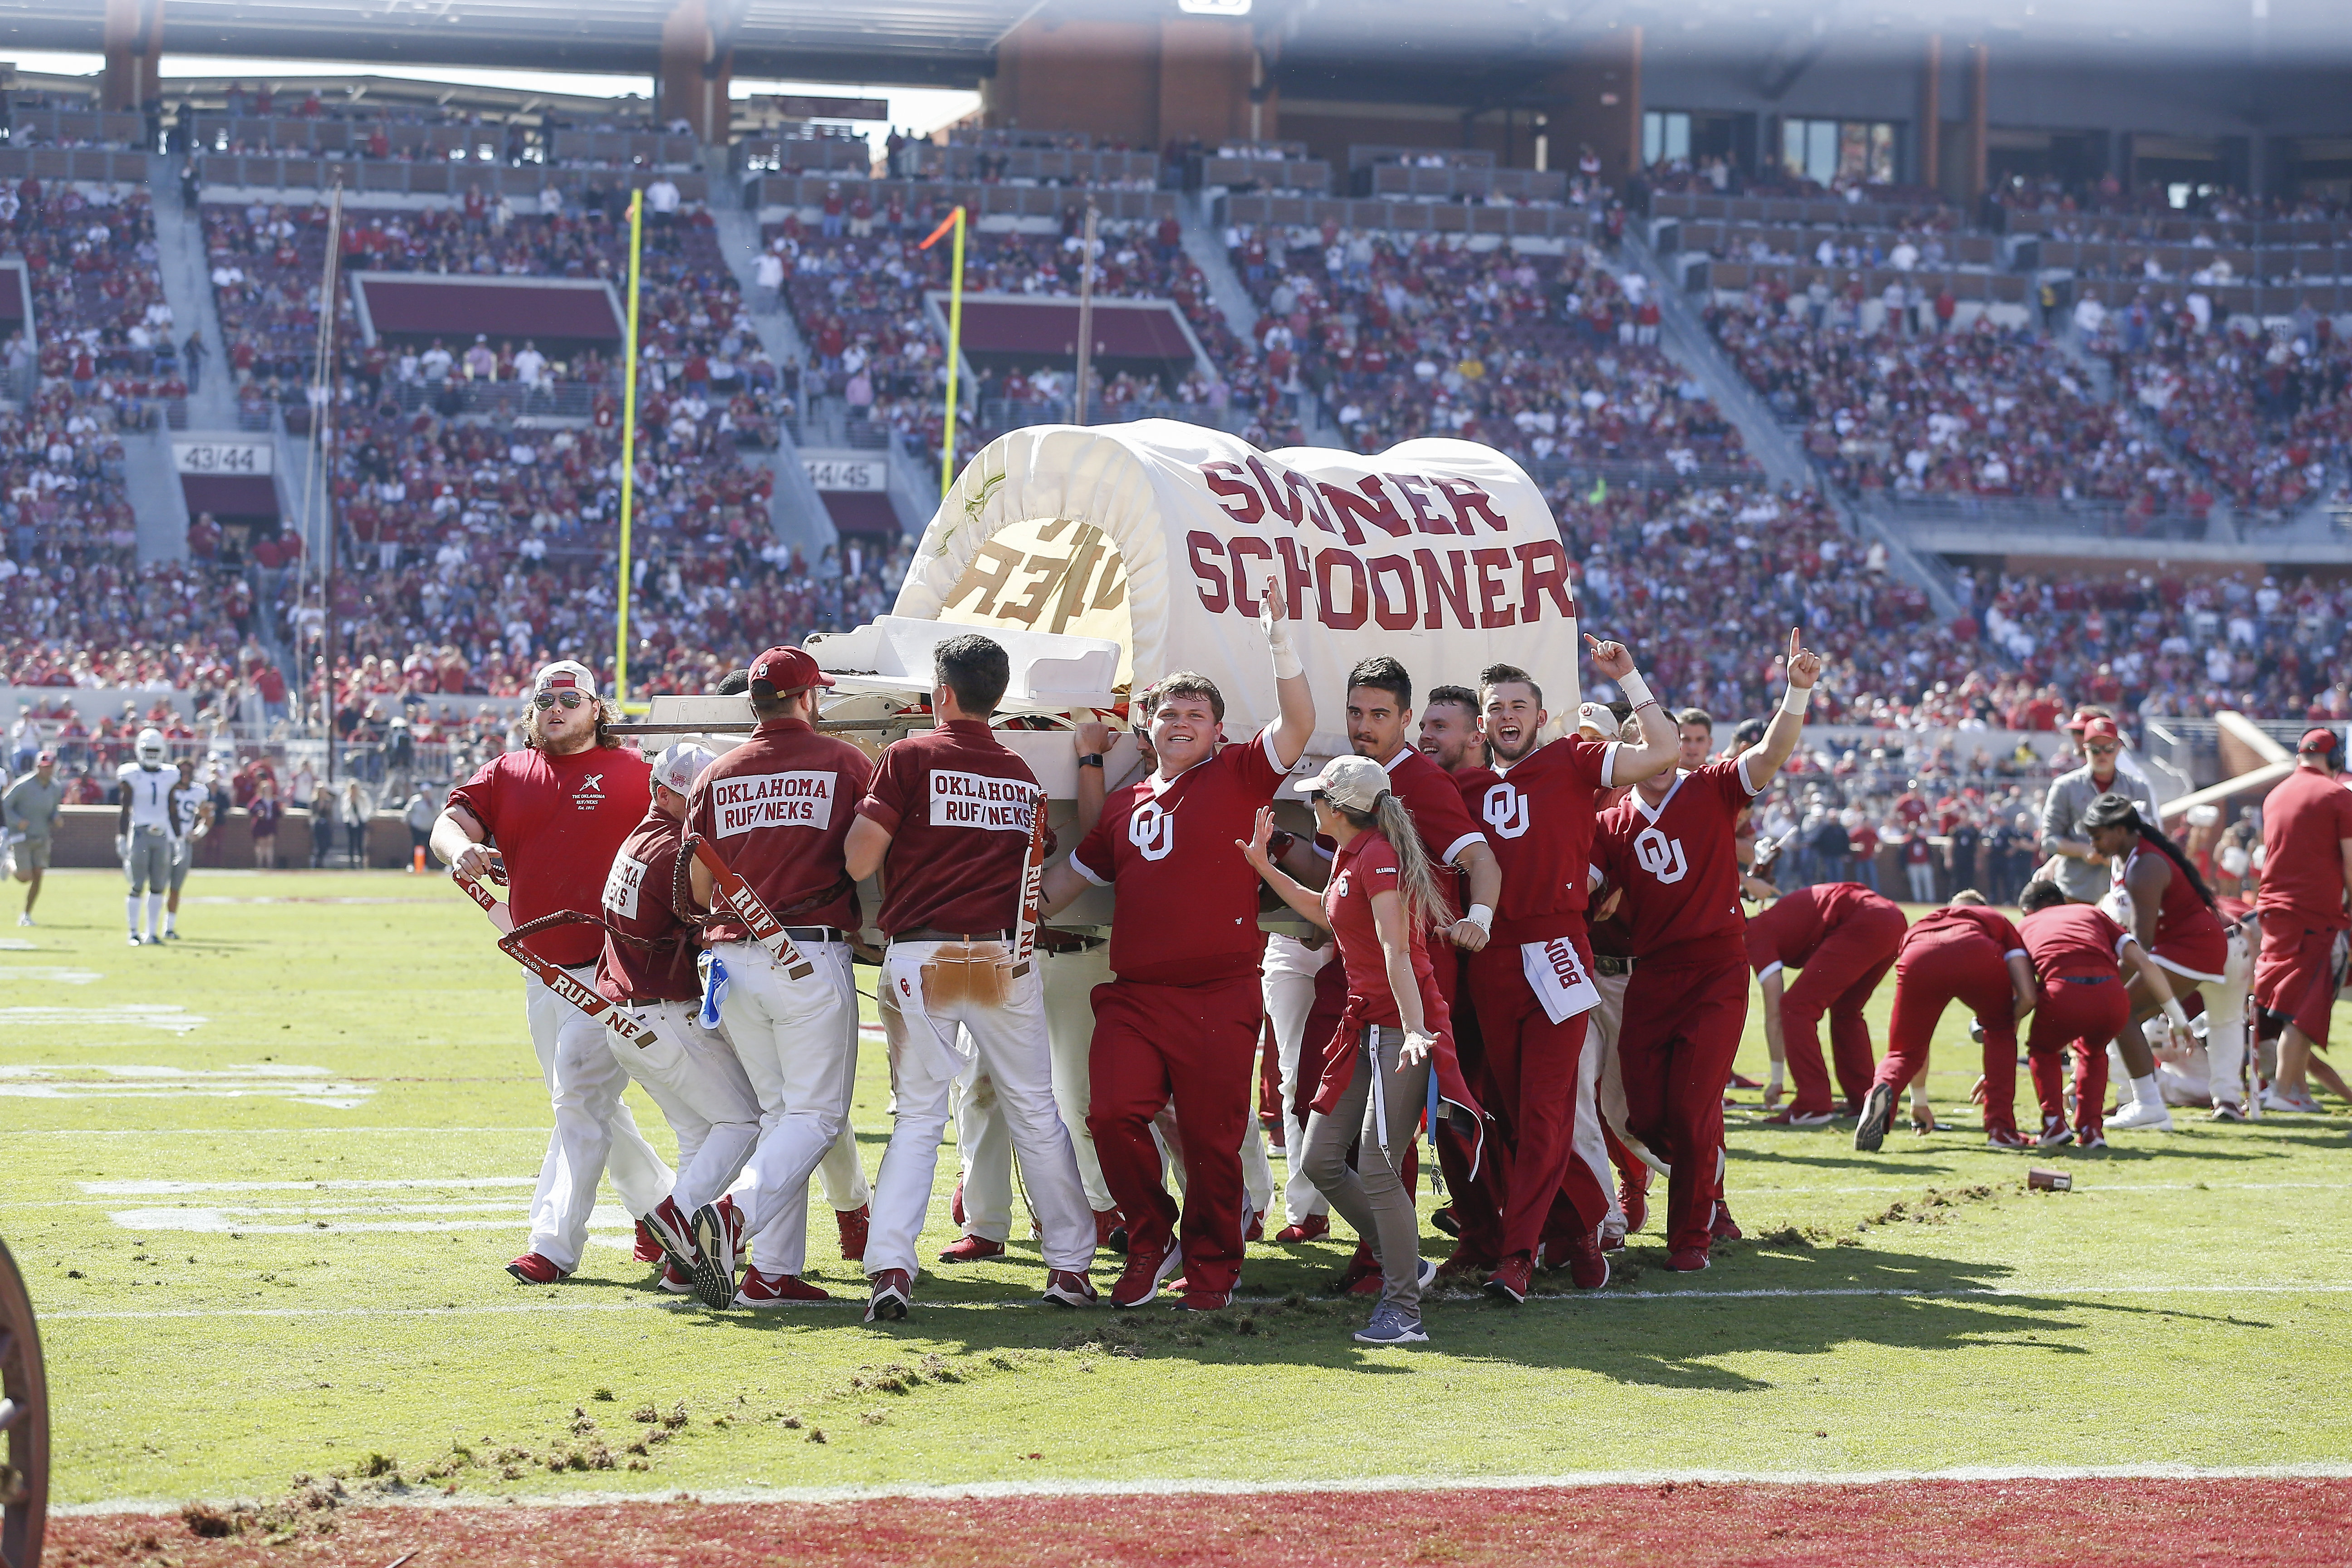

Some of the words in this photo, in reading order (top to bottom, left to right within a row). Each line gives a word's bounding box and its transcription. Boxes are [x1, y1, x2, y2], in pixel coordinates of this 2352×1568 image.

[185, 447, 254, 470] 43/44
[1186, 530, 1575, 631] SCHOONER
[716, 779, 827, 806] OKLAHOMA
[935, 775, 1036, 804] OKLAHOM
[725, 801, 813, 829] RUF/NEKS
[946, 801, 1031, 829] RUF/NEKS
[1483, 782, 1530, 839] OU
[1128, 800, 1174, 861] OU
[1633, 827, 1688, 884] OU
[468, 883, 487, 902] 2
[1025, 864, 1042, 911] RUF
[730, 886, 775, 932] RUF
[550, 974, 598, 1008] RUF
